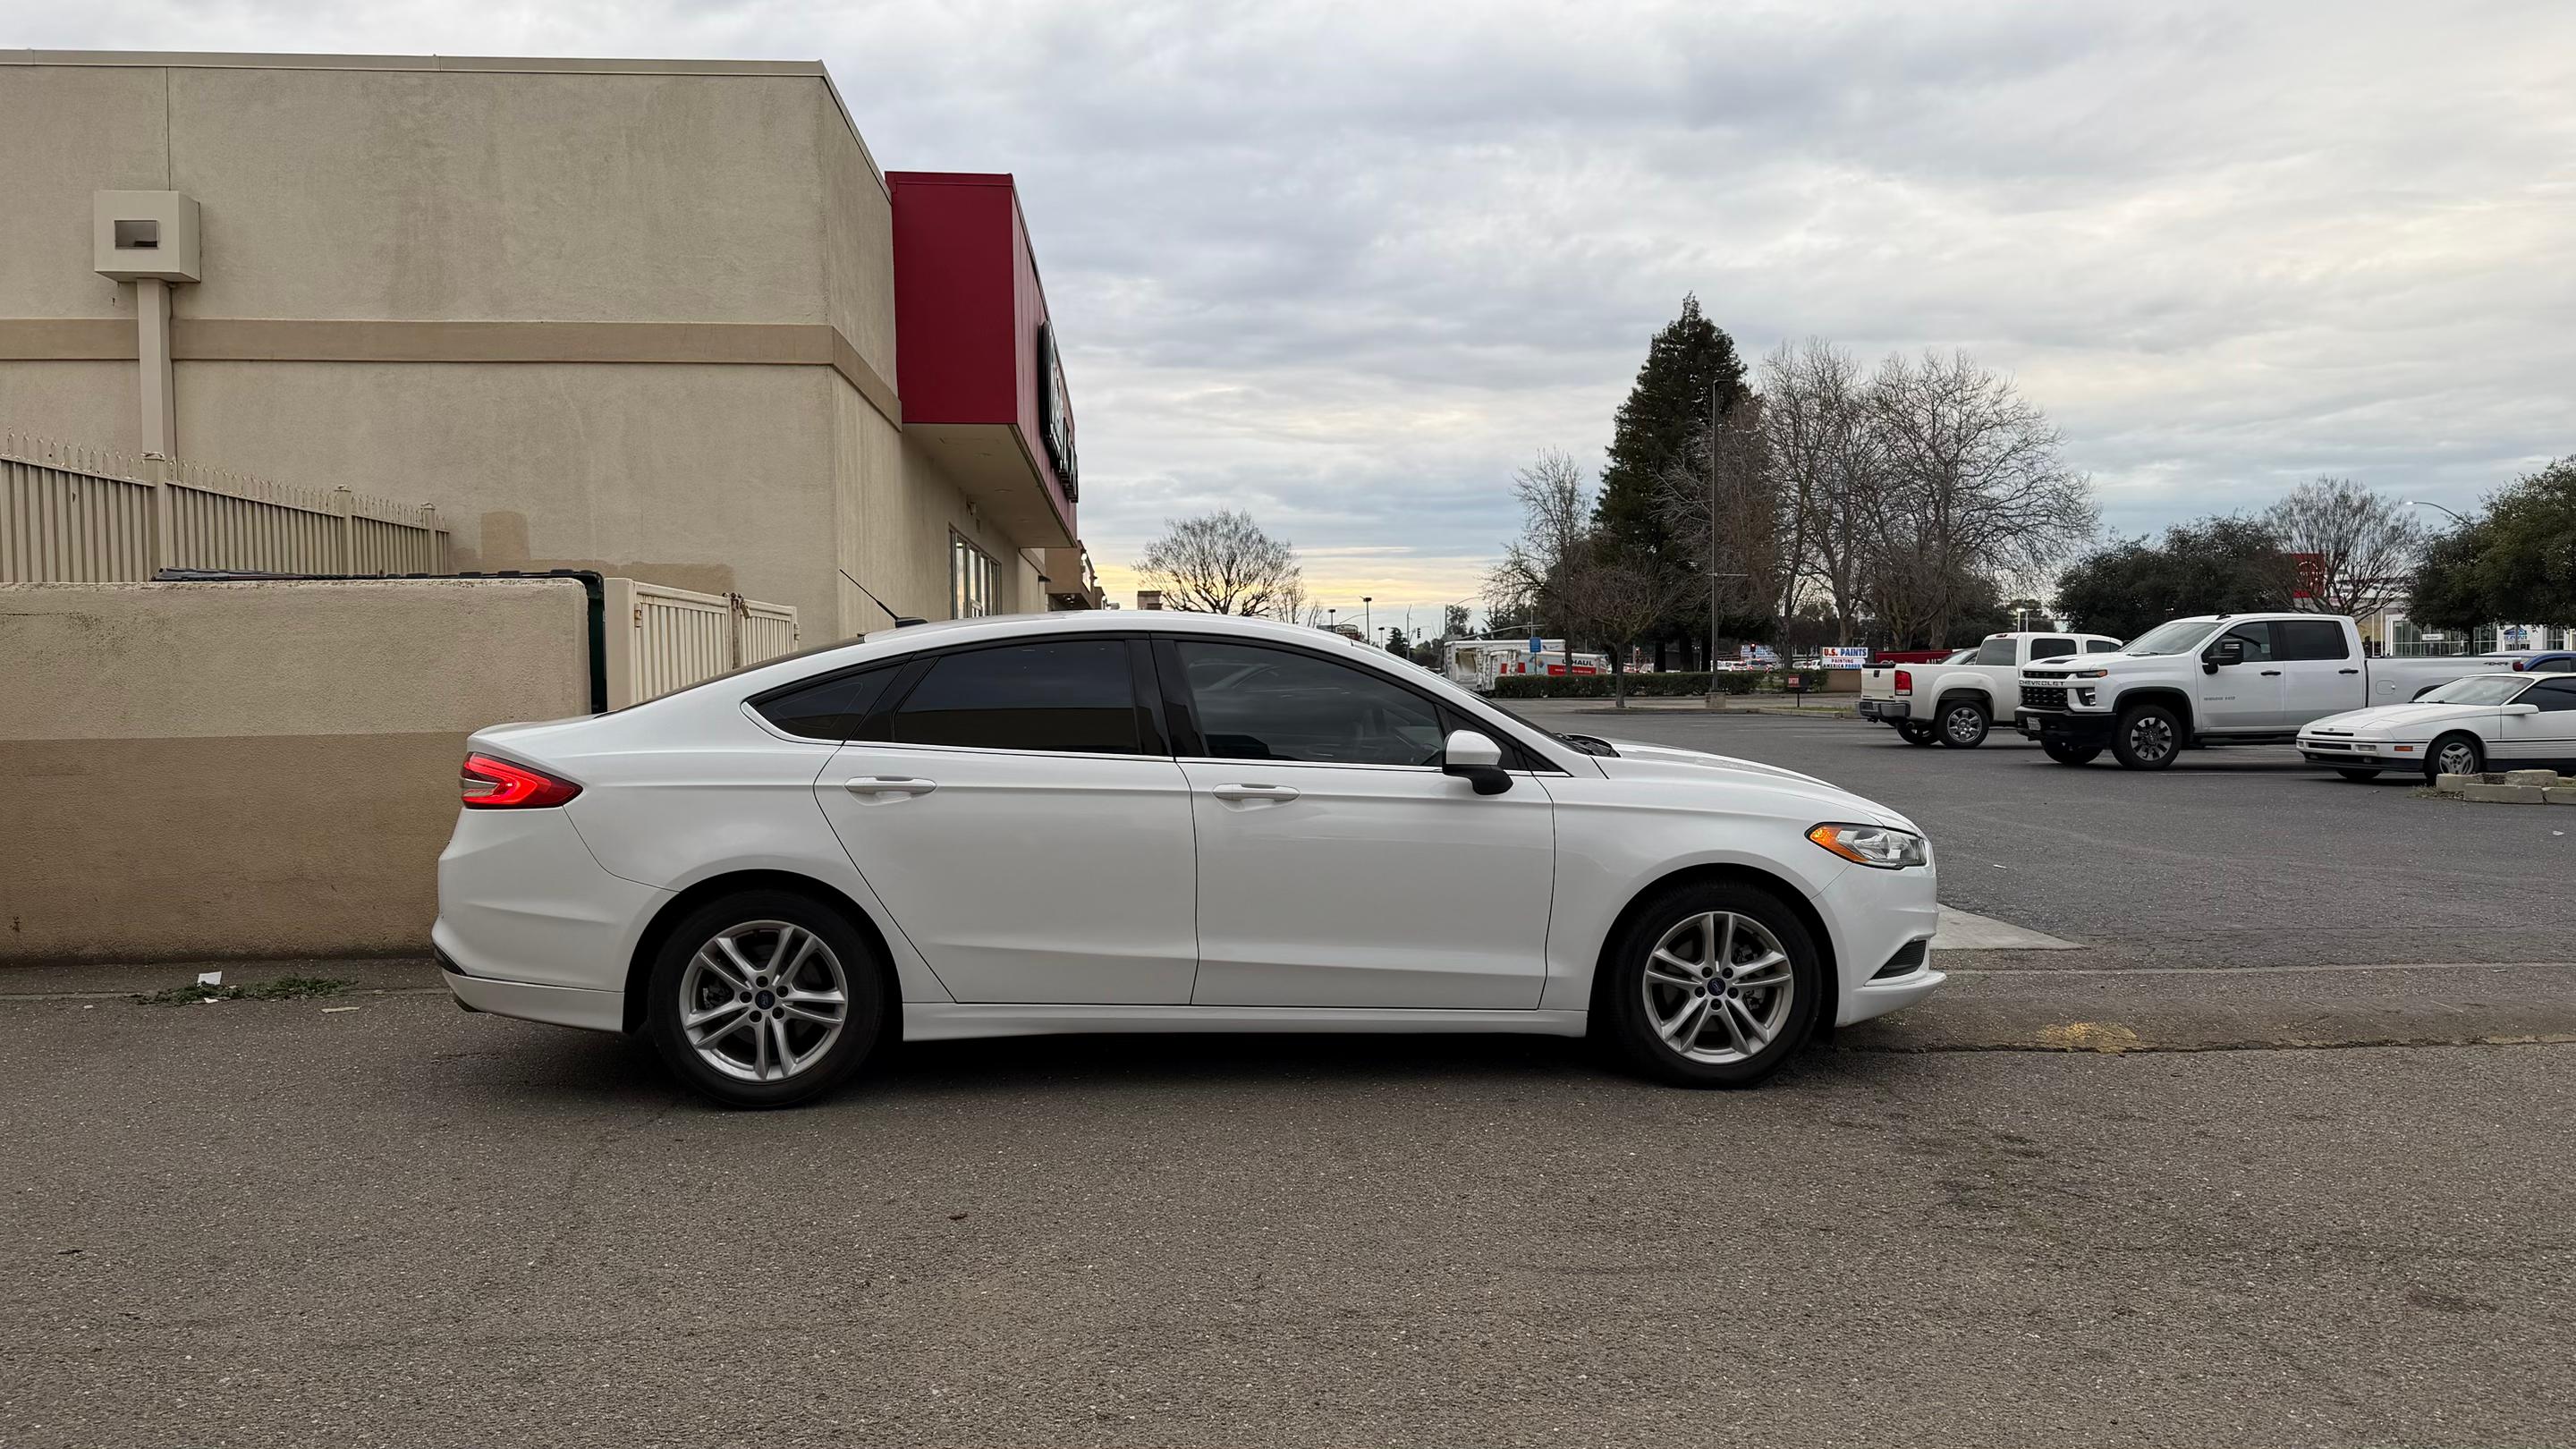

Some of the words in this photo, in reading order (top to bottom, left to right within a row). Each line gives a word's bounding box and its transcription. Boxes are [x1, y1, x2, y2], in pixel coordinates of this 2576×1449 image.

[1824, 648, 1838, 657] U.S.
[1840, 648, 1867, 657] PAINTS
[1562, 658, 1594, 666] UHAUL
